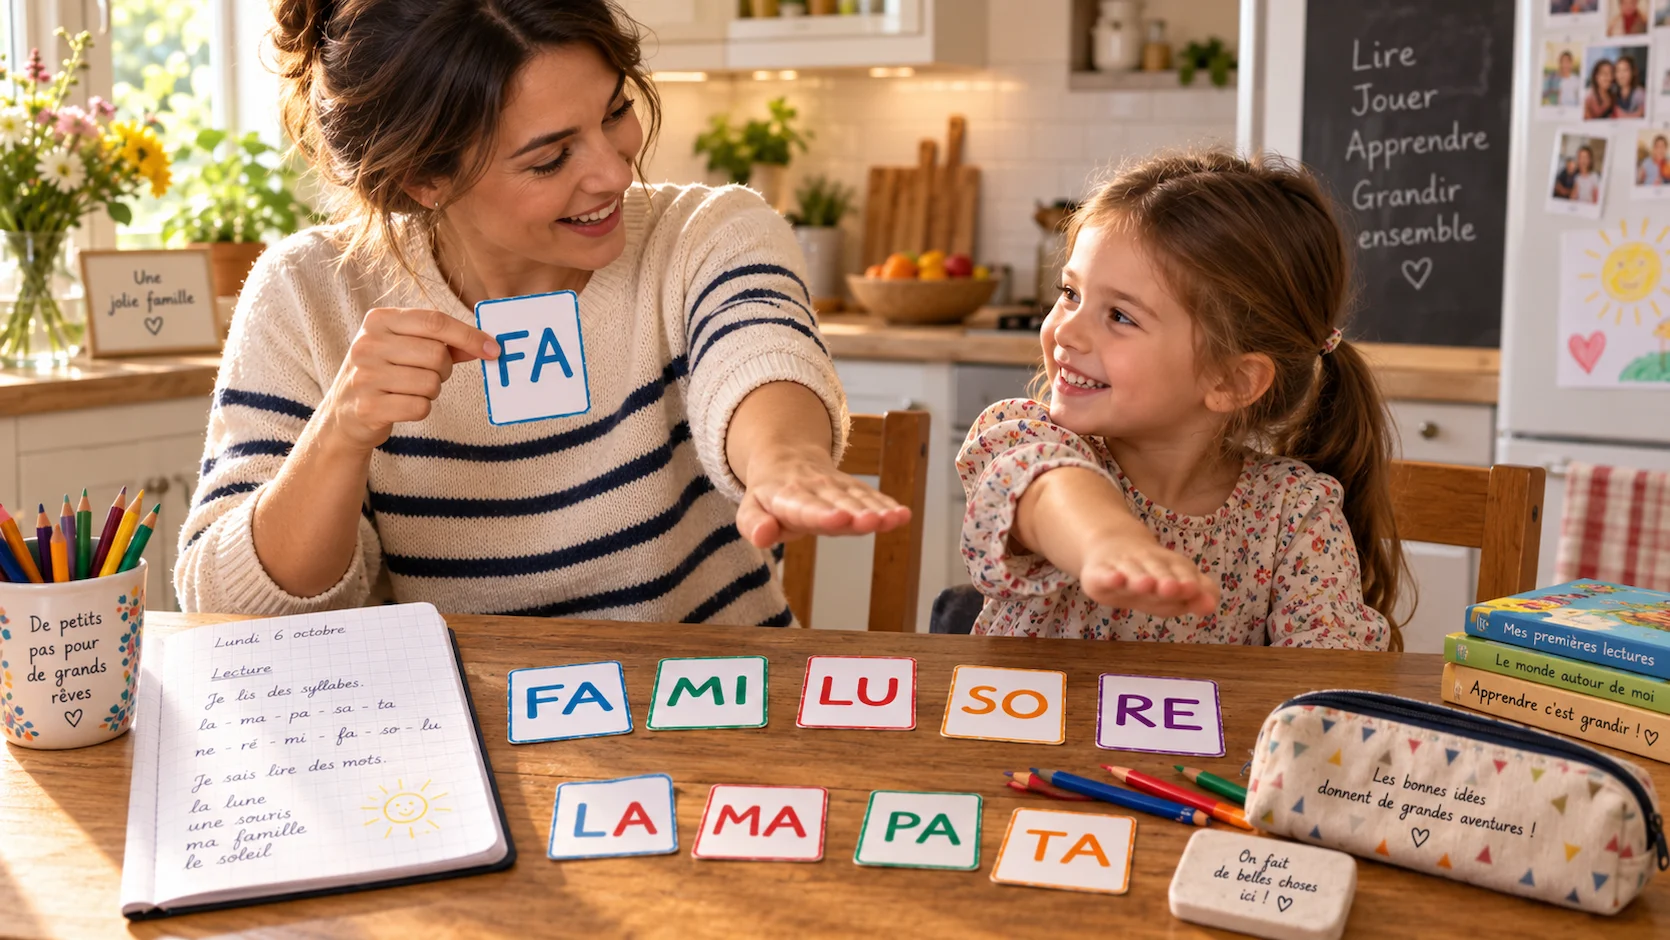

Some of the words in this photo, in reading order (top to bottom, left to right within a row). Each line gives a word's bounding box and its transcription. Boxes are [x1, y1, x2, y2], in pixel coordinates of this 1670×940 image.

[1352, 38, 1417, 71] Lire
[1351, 82, 1439, 117] Jouer
[1345, 120, 1490, 172] Apprendre
[1352, 172, 1463, 211] Grandir
[1358, 212, 1477, 249] ensemble
[133, 269, 162, 285] Une
[107, 291, 139, 316] jolie
[146, 288, 196, 313] famille
[496, 327, 573, 387] FA
[30, 615, 51, 632] De
[60, 611, 102, 637] petits
[214, 634, 260, 648] Lundi
[274, 629, 284, 641] 6
[293, 625, 346, 639] octobre
[29, 645, 55, 664] pas
[64, 639, 100, 660] pour
[1503, 622, 1528, 639] Mes
[1533, 632, 1597, 653] premières
[1603, 641, 1655, 667] lectures
[27, 665, 46, 682] de
[55, 657, 107, 687] grands
[211, 664, 273, 681] Lecture
[1495, 653, 1510, 668] Le
[1515, 660, 1555, 679] monde
[1561, 671, 1604, 690] autour
[1609, 680, 1625, 696] de
[1631, 689, 1655, 703] moi
[52, 688, 91, 704] rêves
[204, 693, 225, 711] Je
[236, 688, 256, 702] lis
[267, 685, 292, 698] des
[300, 678, 365, 699] syllabes.
[526, 681, 614, 719] FA
[666, 675, 748, 707] MI
[819, 675, 899, 706] LU
[961, 685, 1048, 720] SO
[198, 718, 217, 731] la
[240, 715, 266, 725] ma
[289, 710, 310, 725] pa
[333, 705, 354, 714] sa
[378, 699, 396, 710] ta
[1115, 694, 1203, 731] RE
[1470, 680, 1538, 711] Apprendre
[1545, 702, 1575, 721] c'est
[1580, 715, 1630, 735] grandir
[1635, 723, 1641, 738] !
[195, 747, 215, 757] ne
[241, 738, 258, 751] ré
[284, 733, 307, 745] mi
[336, 727, 357, 746] fa
[380, 726, 400, 735] so
[420, 718, 441, 731] lu
[191, 774, 213, 794] Je
[223, 770, 256, 782] sais
[266, 764, 297, 777] lire
[308, 758, 335, 772] des
[343, 755, 387, 769] mots.
[1372, 766, 1396, 786] Les
[1403, 774, 1448, 797] bonnes
[1454, 786, 1486, 805] idées
[187, 818, 225, 832] une
[234, 808, 292, 825] souris
[189, 799, 211, 814] la
[223, 794, 267, 808] lune
[573, 801, 658, 838] LA
[1317, 779, 1373, 804] donnent
[1377, 792, 1394, 809] de
[1399, 803, 1454, 821] grandes
[1460, 815, 1524, 835] aventures
[1530, 821, 1537, 838] !
[186, 839, 219, 852] ma
[233, 821, 307, 850] famille
[713, 804, 807, 838] MA
[884, 811, 962, 846] PA
[184, 854, 203, 870] le
[216, 842, 273, 865] soleil
[1026, 828, 1111, 868] TA
[1239, 849, 1257, 864] On
[1262, 853, 1290, 873] fait
[1213, 865, 1230, 879] de
[1236, 868, 1273, 886] belles
[1278, 875, 1318, 893] choses
[1240, 889, 1257, 902] ici
[1262, 890, 1270, 904] !
